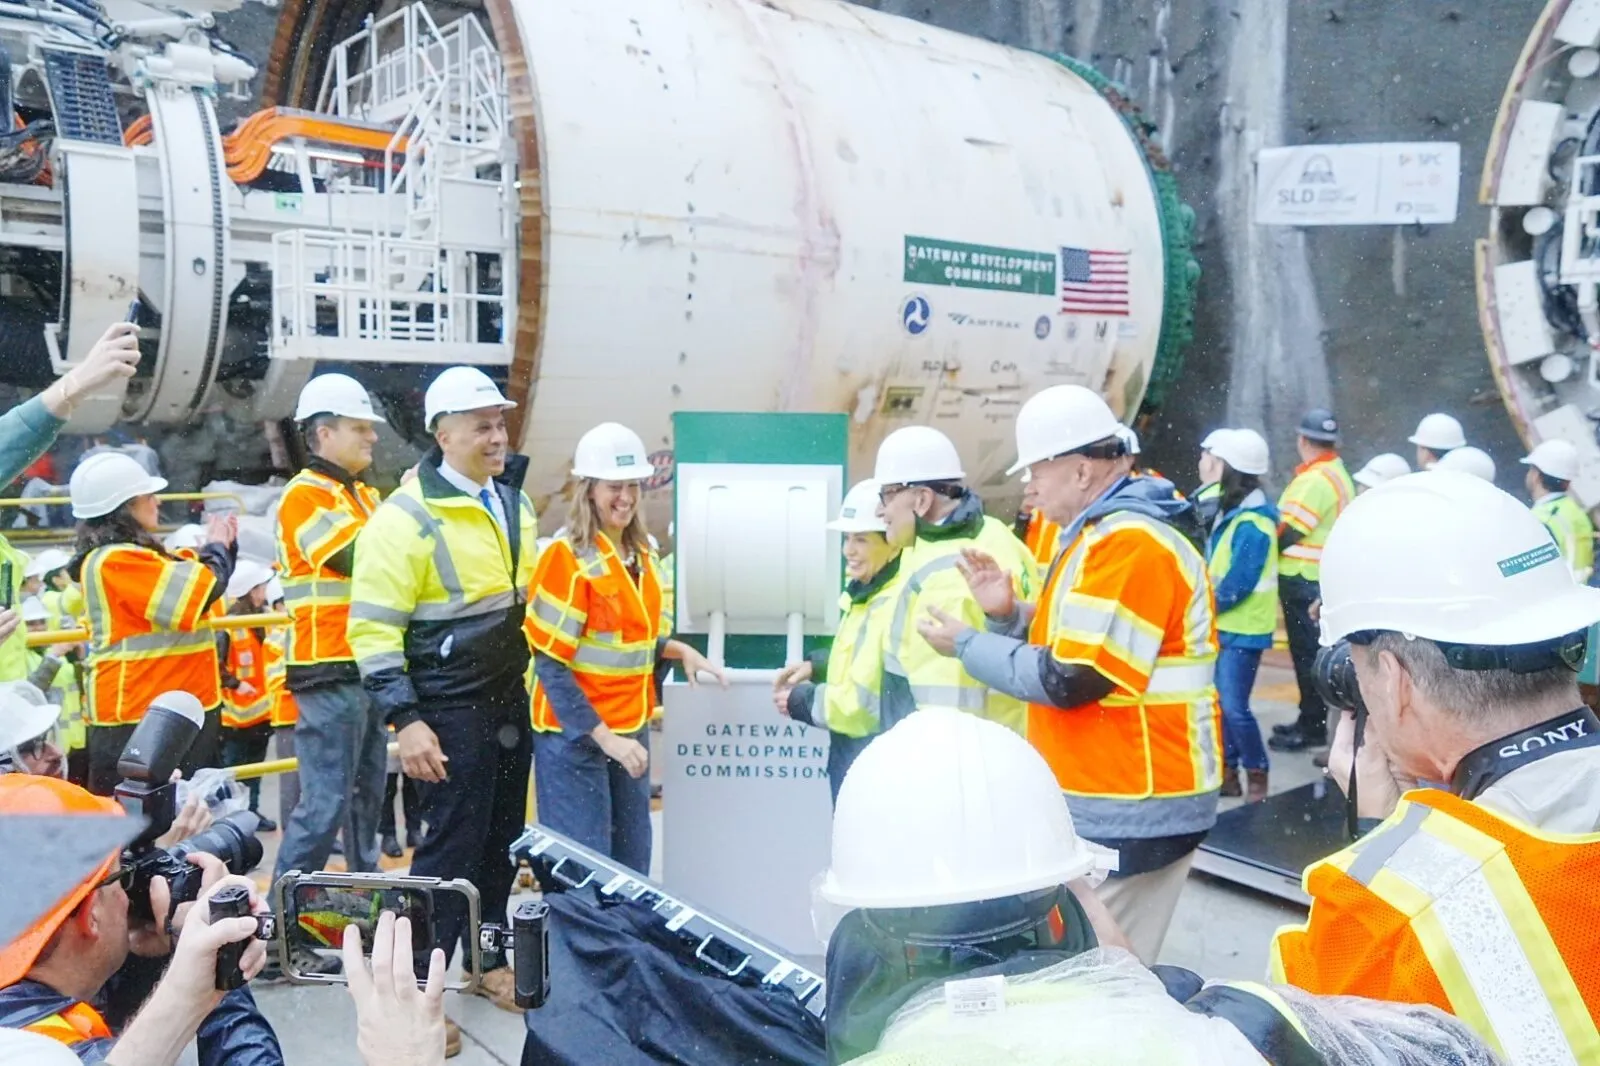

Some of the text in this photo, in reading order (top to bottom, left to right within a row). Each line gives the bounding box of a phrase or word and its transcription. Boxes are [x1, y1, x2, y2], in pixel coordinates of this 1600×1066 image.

[1277, 188, 1315, 205] SLD
[908, 245, 1054, 273] GATEWAY DEVELOPMENT
[944, 266, 1021, 285] COMMISSION
[705, 724, 808, 738] GATEWAY
[1499, 719, 1588, 758] SONY
[677, 743, 826, 758] DEVELOPMEN
[685, 764, 829, 779] COMMISSION
